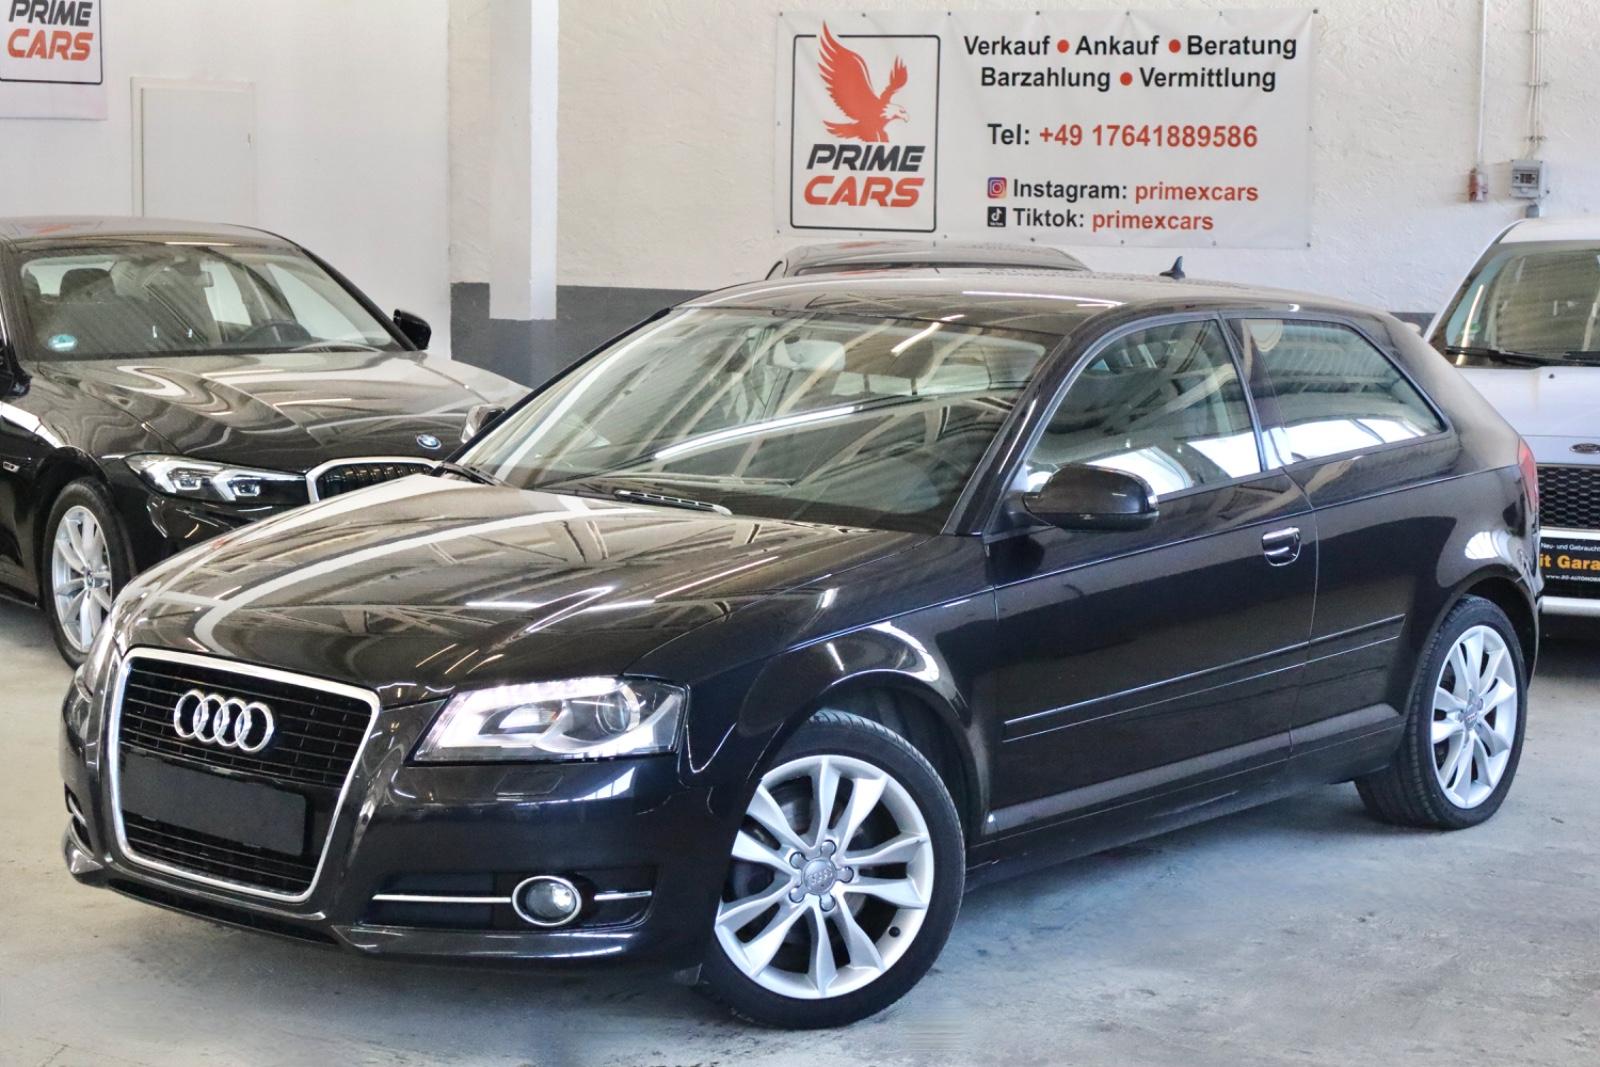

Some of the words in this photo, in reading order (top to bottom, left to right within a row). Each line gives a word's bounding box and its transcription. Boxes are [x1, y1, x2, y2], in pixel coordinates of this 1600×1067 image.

[8, 0, 93, 27] PRIME
[7, 28, 94, 62] CARS
[964, 35, 1051, 57] Verkauf
[1075, 35, 1161, 56] Ankauf
[1187, 35, 1297, 60] Beratung
[980, 66, 1111, 92] Barzahlung
[1139, 66, 1277, 92] Vermittlung
[987, 123, 1030, 146] Tel:
[1039, 125, 1083, 147] +49
[1092, 124, 1259, 149] 17641889586
[806, 143, 926, 172] PRIME
[804, 175, 925, 208] CARS
[1013, 178, 1128, 202] Instagram:
[1135, 181, 1259, 204] primexcars
[1012, 207, 1085, 228] Tiktok:
[1092, 210, 1214, 232] primexcars
